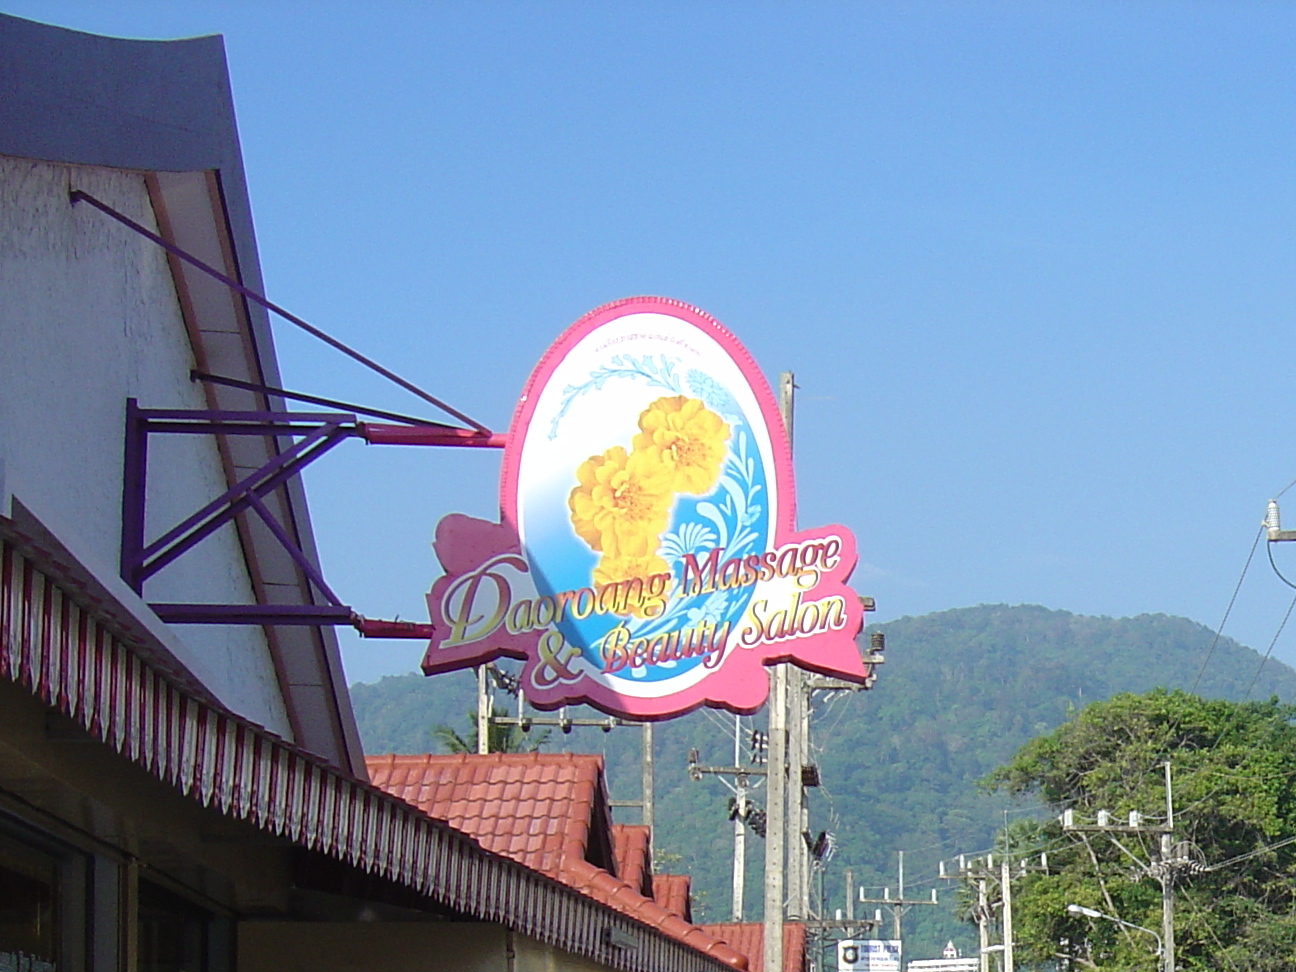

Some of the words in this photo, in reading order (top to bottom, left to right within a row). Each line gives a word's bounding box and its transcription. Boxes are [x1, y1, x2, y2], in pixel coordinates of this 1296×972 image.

[440, 555, 671, 649] Daoroang
[676, 538, 841, 598] Massage
[533, 630, 585, 687] &
[600, 621, 731, 674] Beauty
[740, 592, 846, 646] Salon
